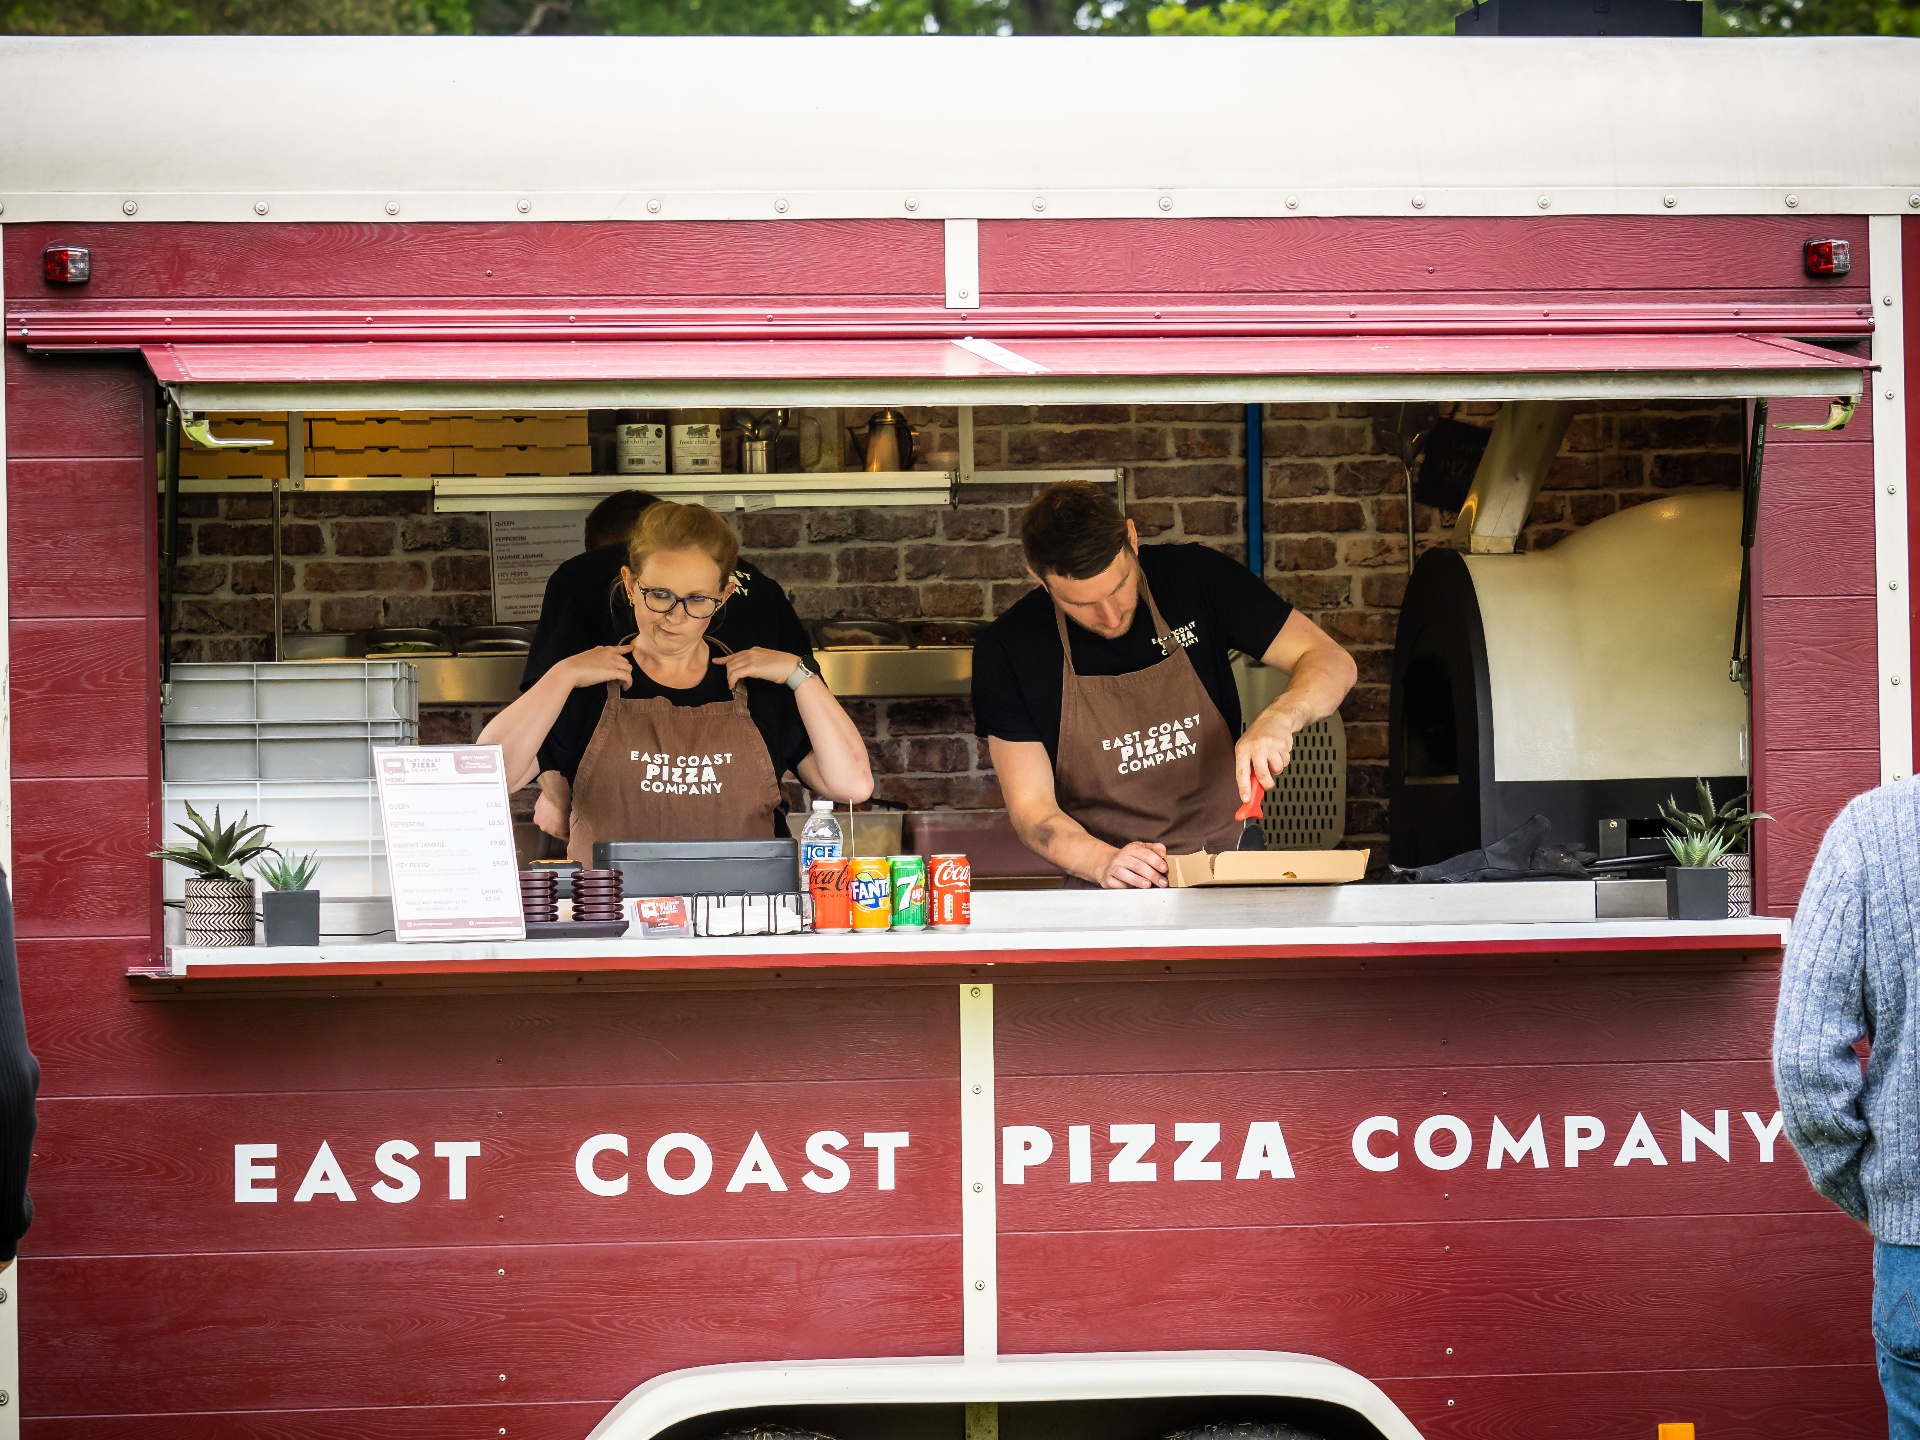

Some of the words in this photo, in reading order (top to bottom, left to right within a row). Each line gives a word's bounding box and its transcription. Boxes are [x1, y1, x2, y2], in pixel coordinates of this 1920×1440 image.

[1175, 621, 1196, 636] COAST
[1101, 730, 1141, 751] EAST
[1148, 714, 1201, 738] COAST
[1120, 731, 1191, 762] PIZZA
[630, 750, 670, 765] EAST
[676, 753, 733, 767] COAST
[1117, 742, 1197, 775] COMPANY
[645, 763, 717, 784] PIZZA
[640, 779, 723, 795] COMPANY
[807, 846, 833, 858] ICE
[409, 861, 430, 869] PESTO
[852, 881, 890, 900] FANTA
[898, 875, 919, 912] 7
[911, 887, 924, 901] up
[234, 1140, 480, 1204] EAST
[575, 1130, 910, 1197] COAST
[1002, 1120, 1296, 1185] PIZZA
[1351, 1108, 1785, 1172] COMPANY
